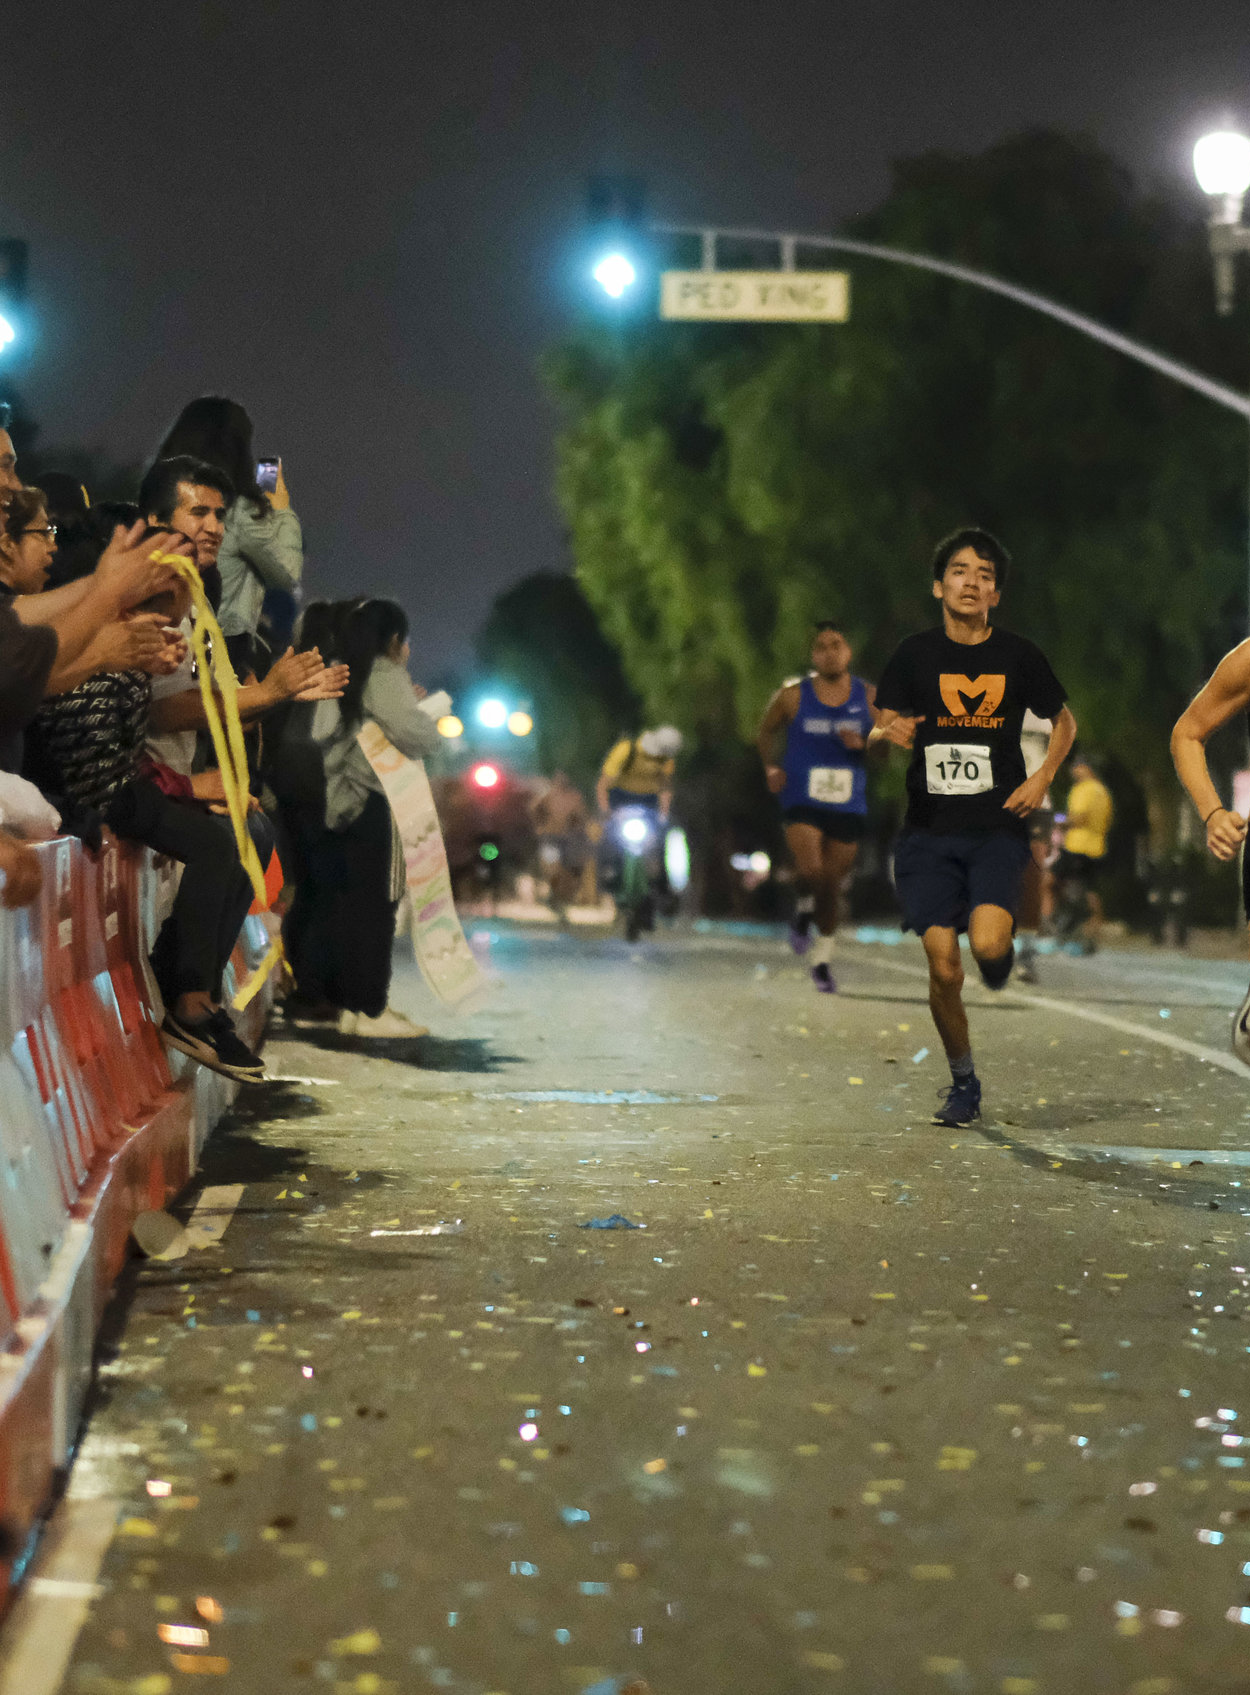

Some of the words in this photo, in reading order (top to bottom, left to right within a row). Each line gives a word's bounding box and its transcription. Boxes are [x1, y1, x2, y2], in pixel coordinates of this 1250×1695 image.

[679, 281, 741, 309] PED
[937, 716, 1005, 729] MOVEMENT
[936, 761, 979, 780] 170
